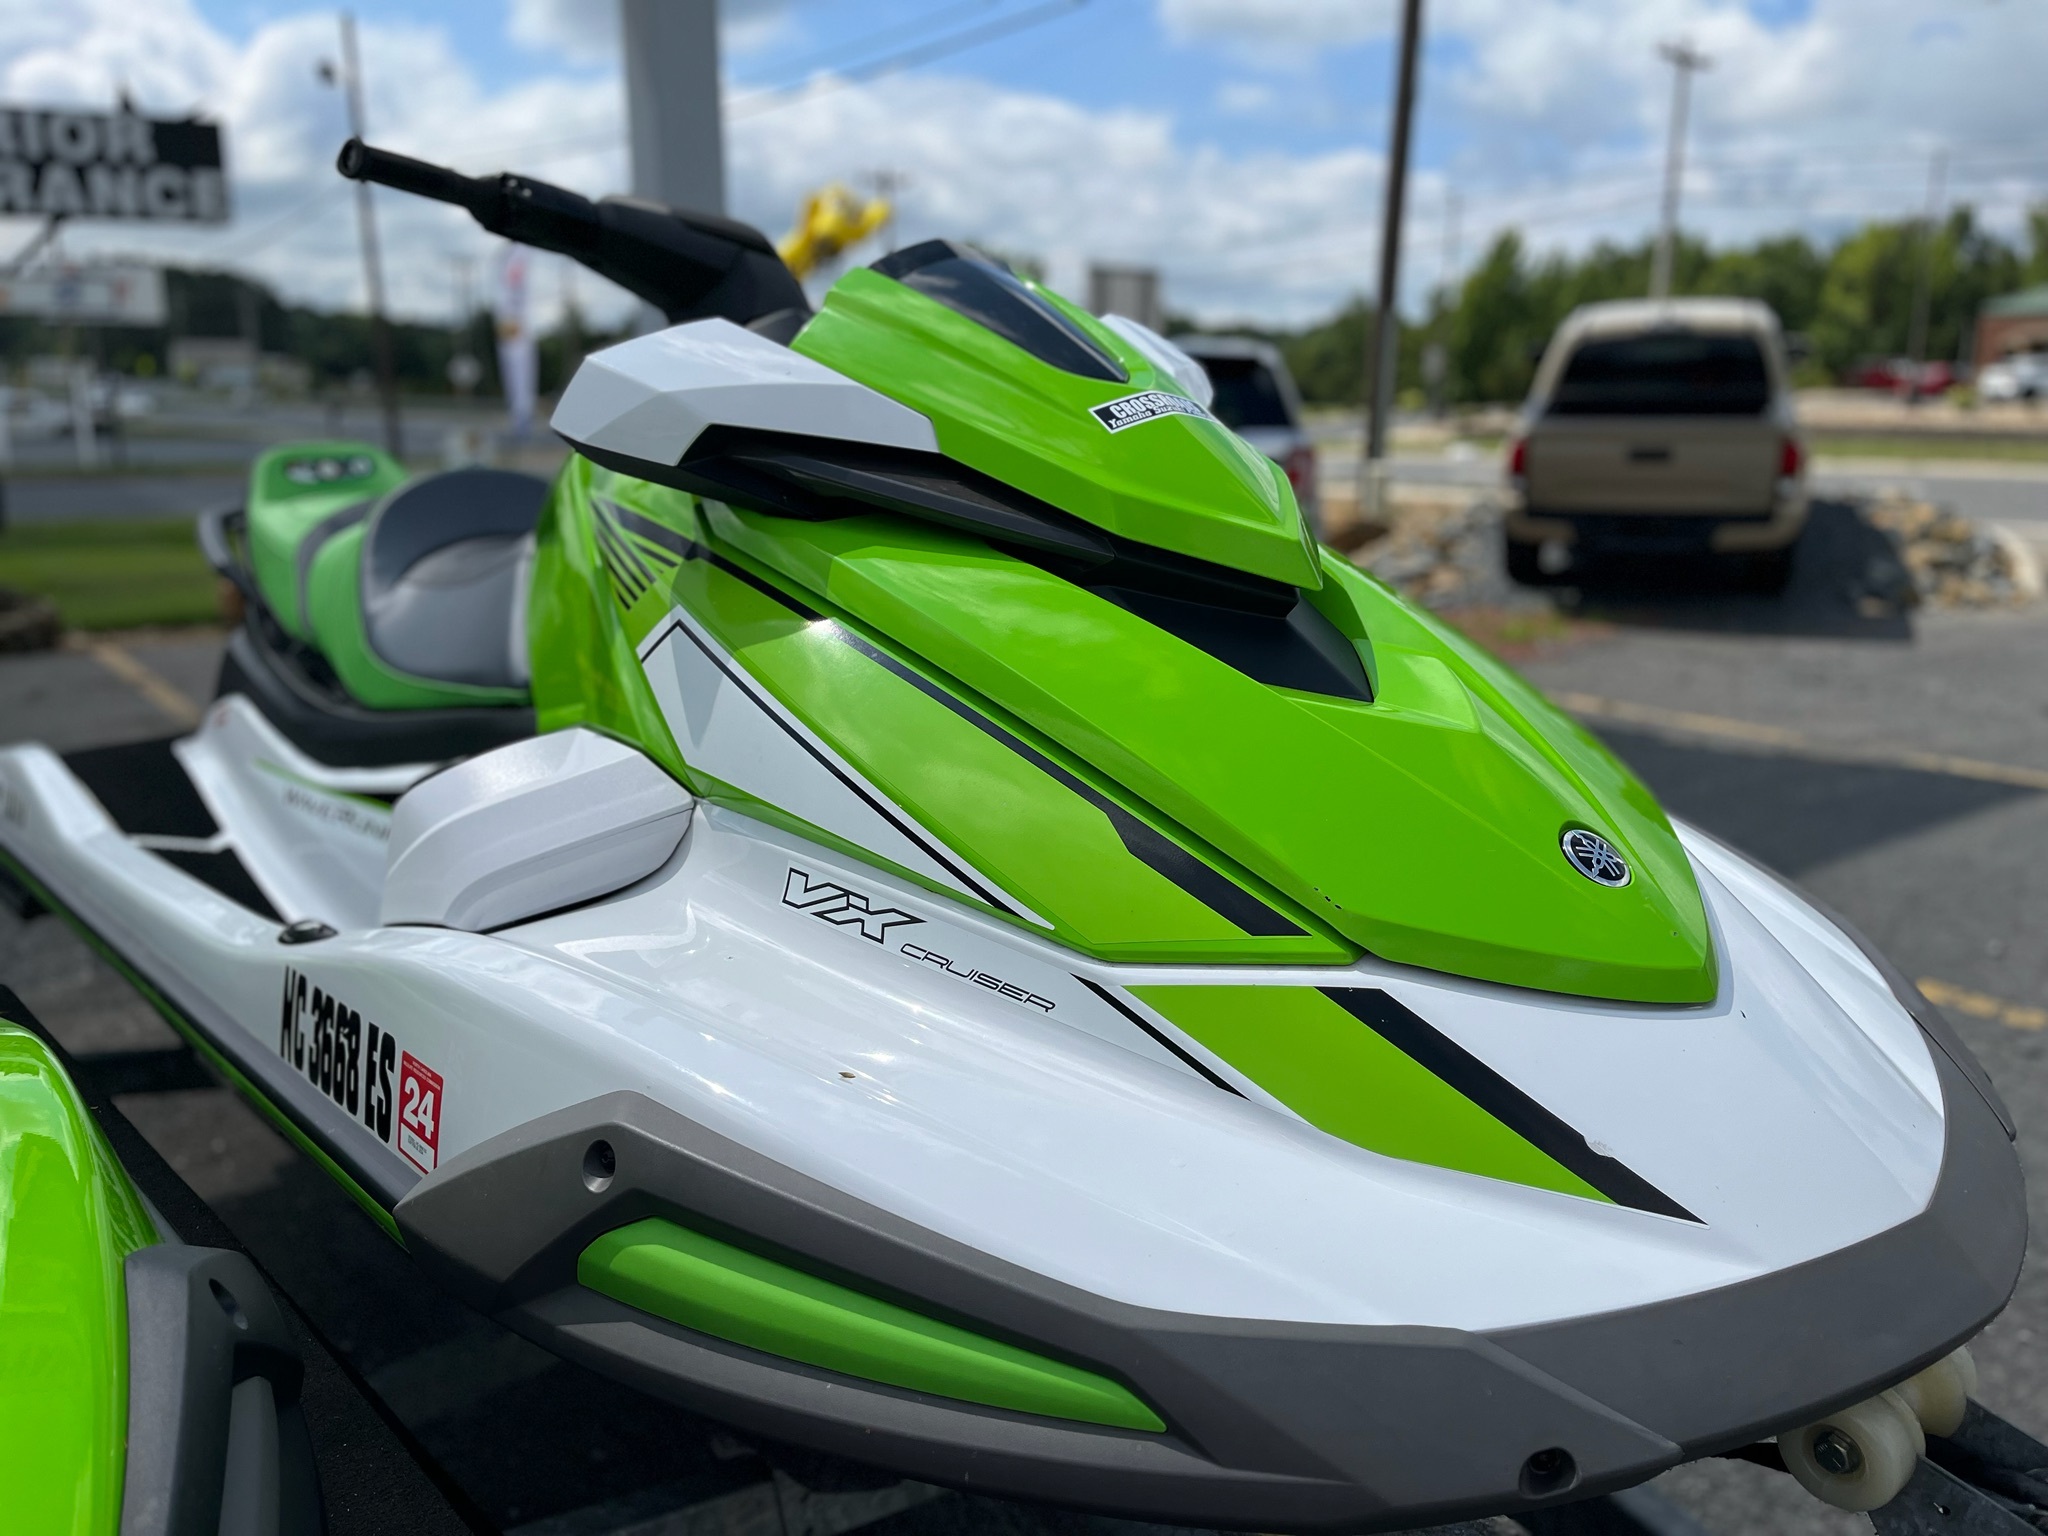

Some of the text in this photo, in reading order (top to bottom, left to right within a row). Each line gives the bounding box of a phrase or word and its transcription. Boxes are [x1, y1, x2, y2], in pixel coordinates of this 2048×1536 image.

[1108, 410, 1153, 429] Yamaha
[782, 867, 1056, 1013] VX CRUISER
[280, 964, 396, 1144] NC 3668 ES
[402, 1075, 435, 1140] 24
